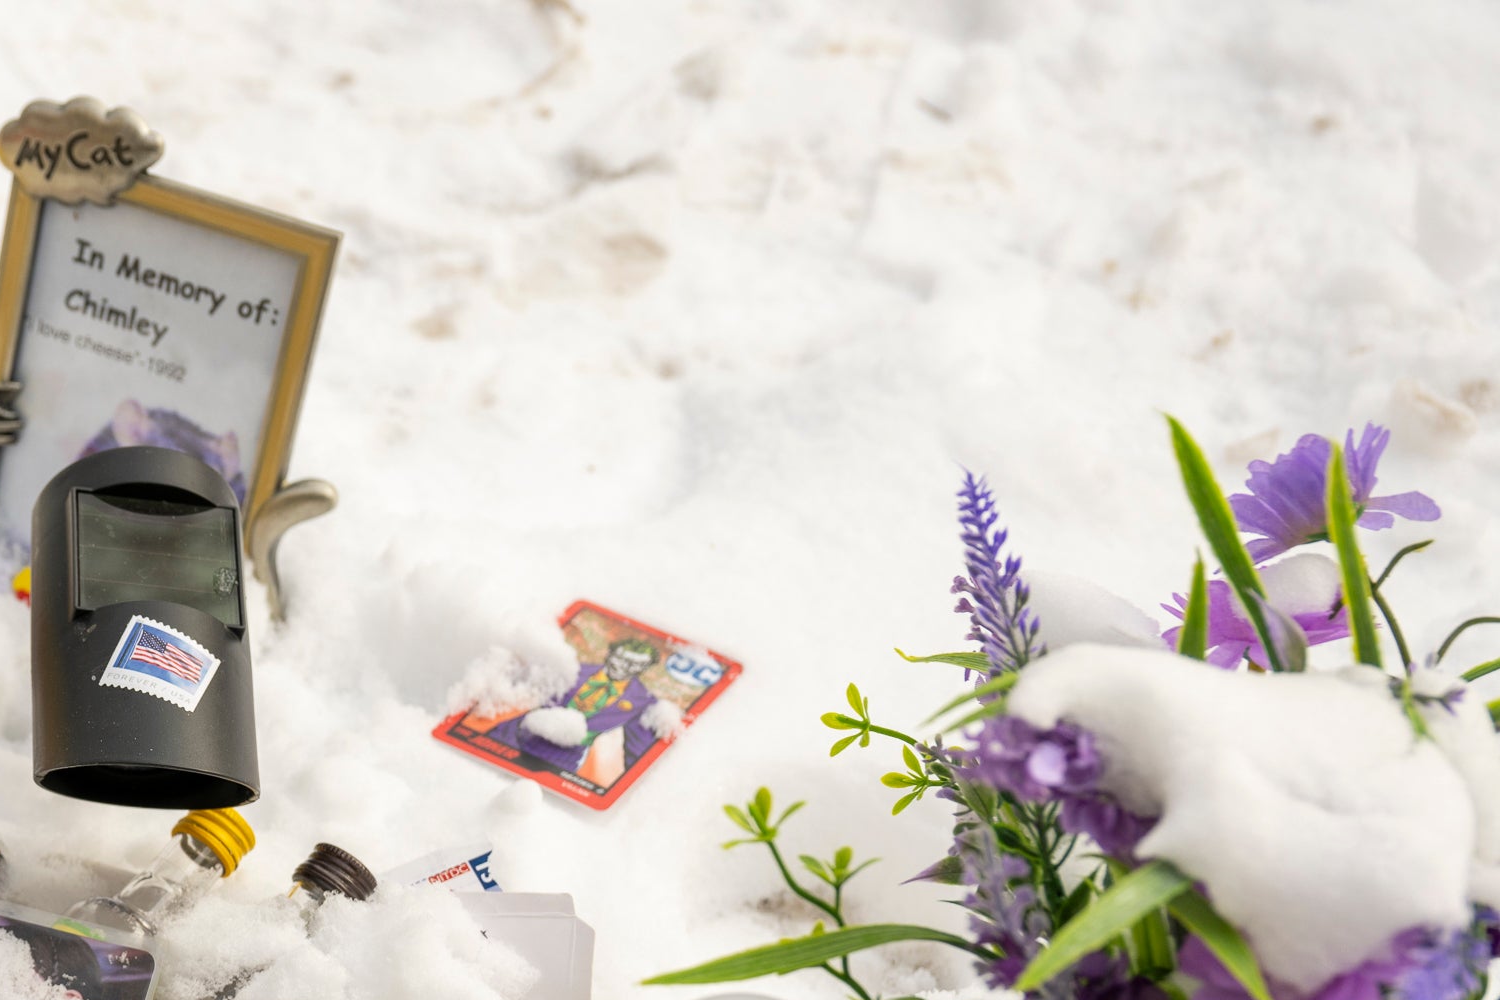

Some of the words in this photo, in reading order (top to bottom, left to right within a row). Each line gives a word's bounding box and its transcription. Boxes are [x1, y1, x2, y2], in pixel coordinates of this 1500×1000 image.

[72, 238, 104, 271] In
[116, 254, 227, 317] Memory
[238, 298, 280, 327] of:
[64, 289, 169, 346] Chimley
[106, 672, 158, 689] FOREVER
[170, 689, 192, 704] USA
